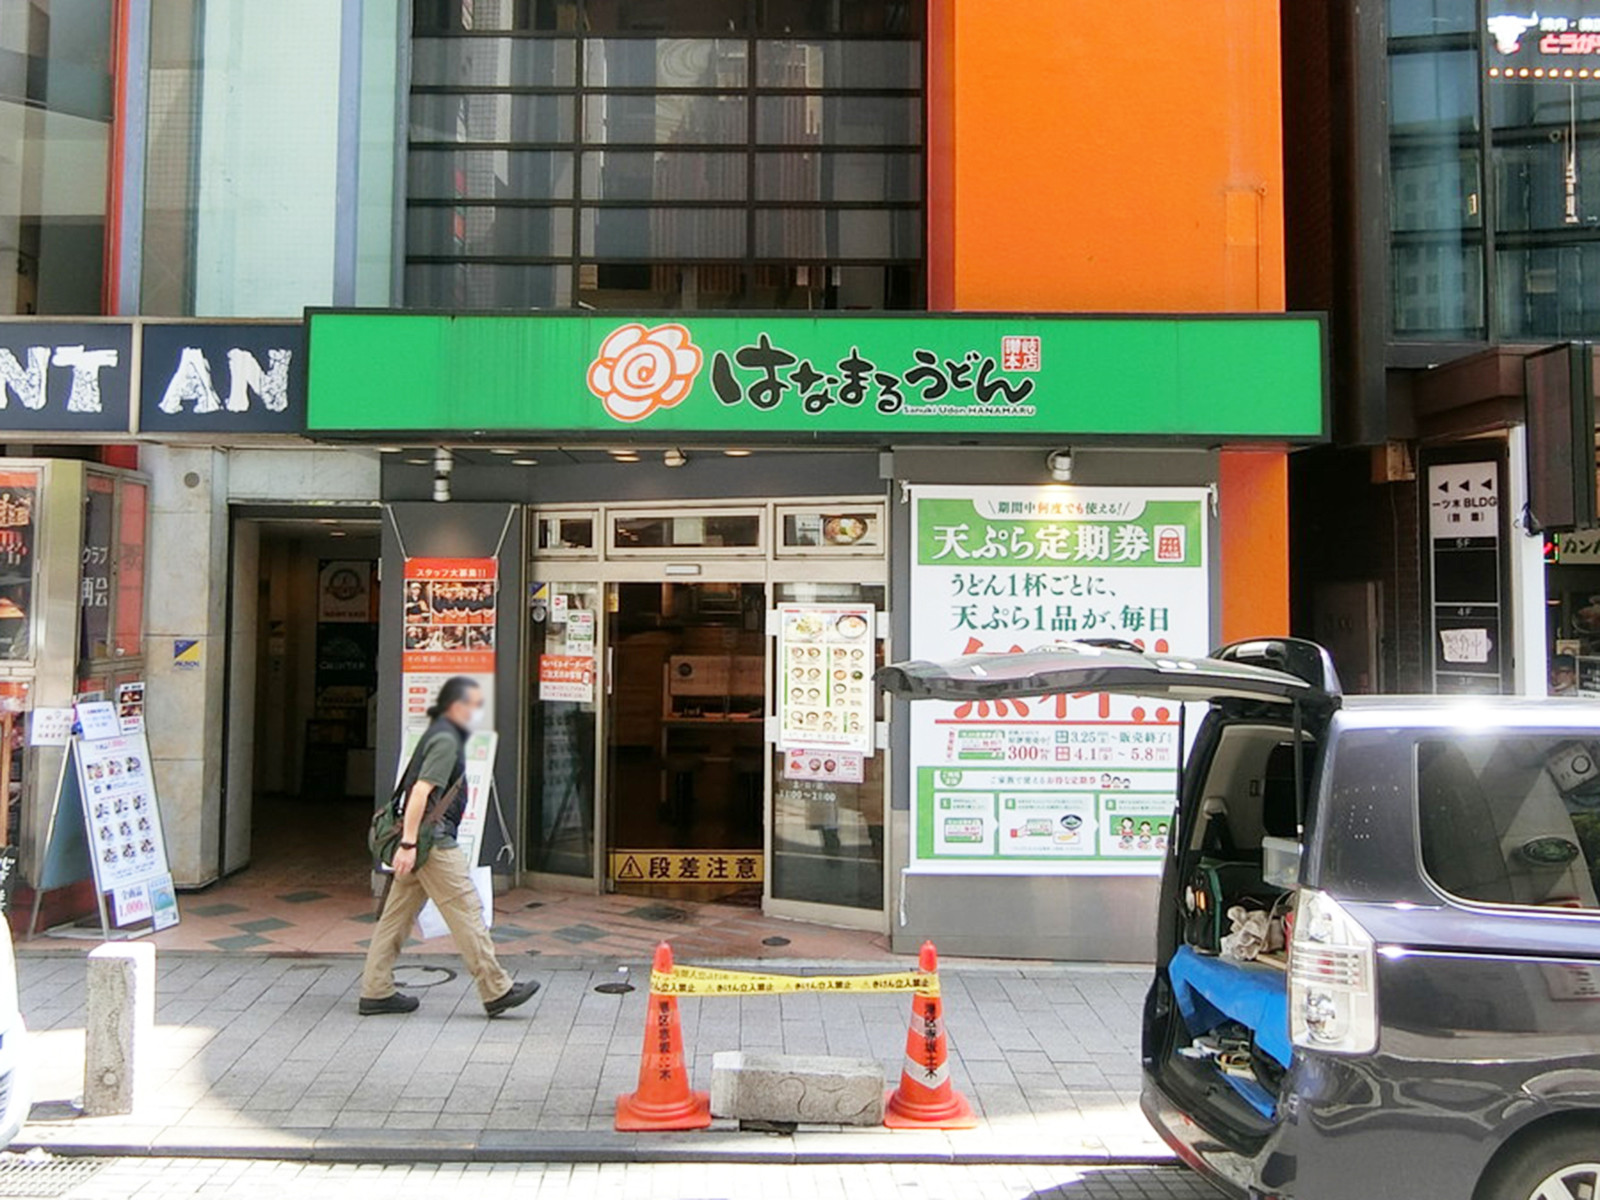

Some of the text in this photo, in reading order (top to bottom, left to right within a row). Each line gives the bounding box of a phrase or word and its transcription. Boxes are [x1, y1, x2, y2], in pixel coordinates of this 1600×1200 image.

[158, 347, 292, 413] AN
[712, 332, 1034, 414] はなまるうどん
[1464, 496, 1497, 508] BLDG
[932, 523, 1150, 562] 天ぷら定期券
[950, 572, 1117, 598] うどん1杯ごとに、
[949, 604, 1170, 633] 天ぷら1品が、毎日
[1008, 745, 1039, 760] 300
[649, 856, 757, 879] 段差注意
